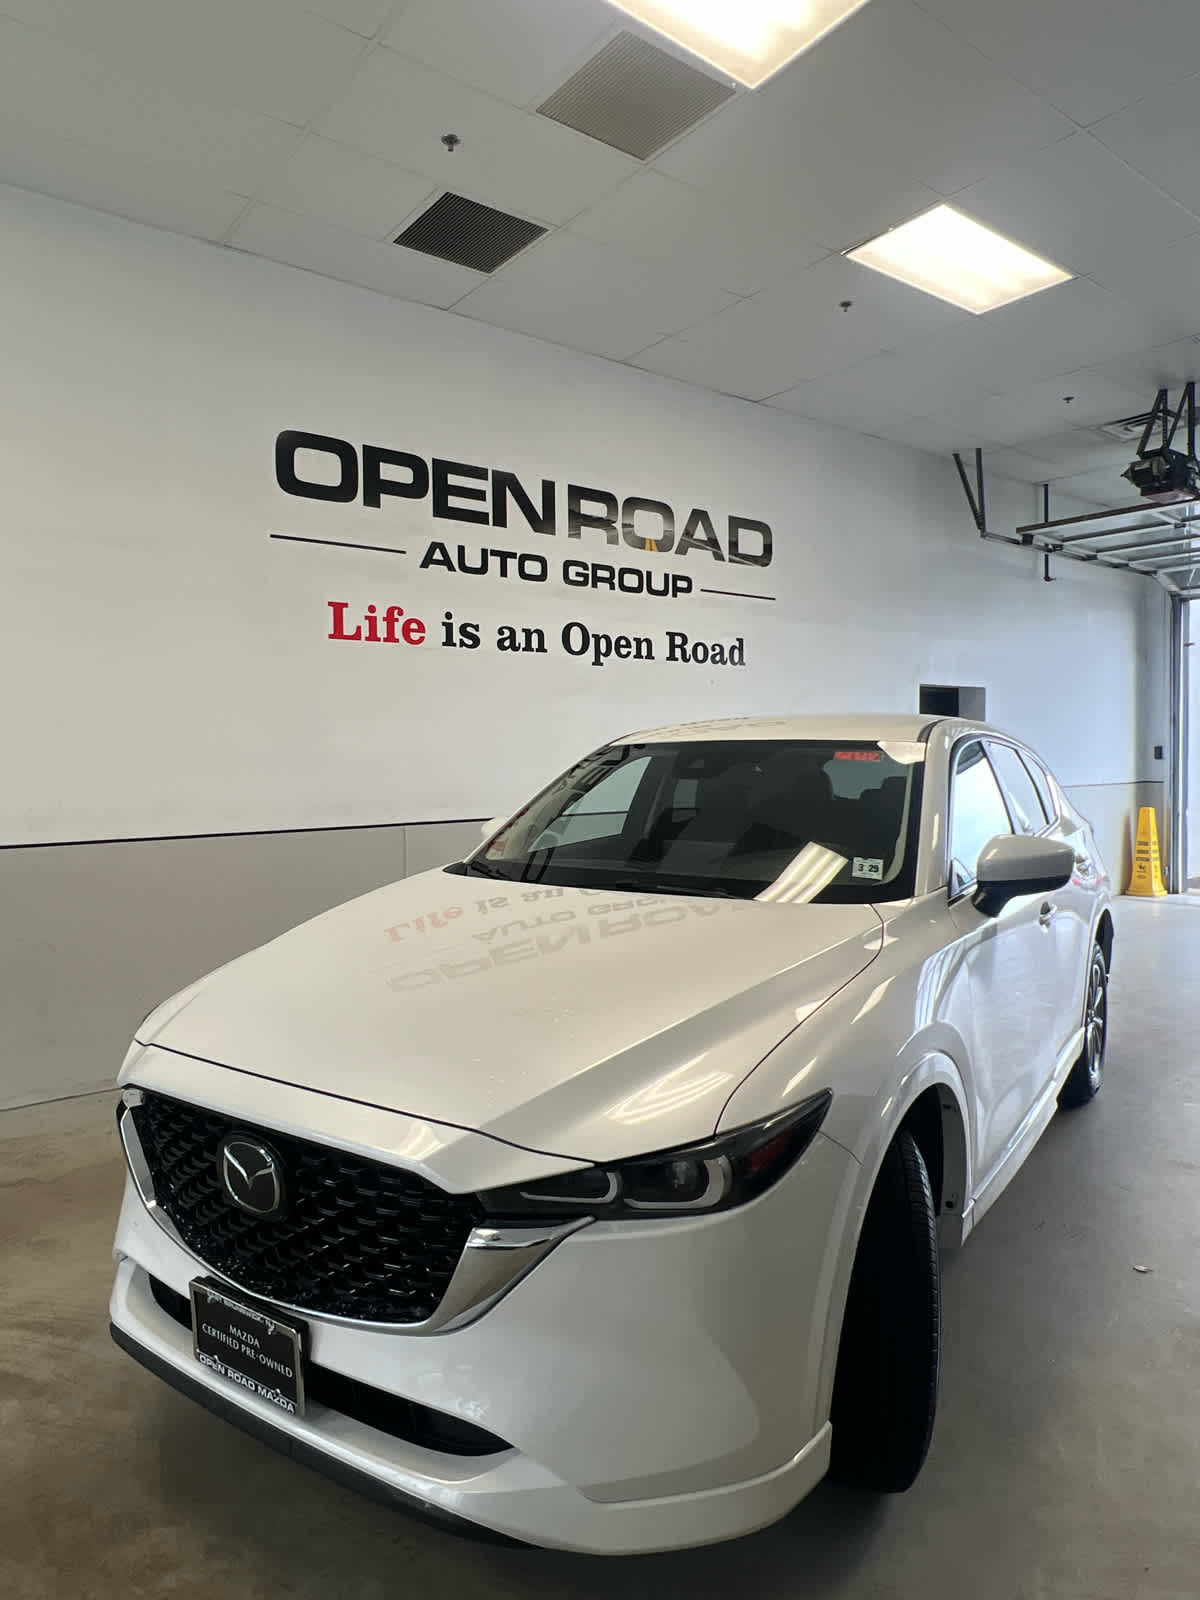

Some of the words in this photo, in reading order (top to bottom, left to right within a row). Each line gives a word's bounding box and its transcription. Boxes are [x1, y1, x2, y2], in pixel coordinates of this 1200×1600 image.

[419, 541, 548, 583] AUTO
[562, 559, 693, 599] GROUP
[327, 601, 426, 646] Life
[441, 611, 481, 650] is
[496, 625, 548, 654] an
[561, 621, 656, 667] Open
[665, 631, 746, 667] Road
[201, 1323, 240, 1351] CERTIFIED
[241, 1343, 293, 1378] PRE-OWNED
[229, 1324, 261, 1349] MAZDA
[199, 1354, 226, 1375] OPEN
[227, 1370, 256, 1392] ROAD
[257, 1385, 295, 1415] MAZDA
